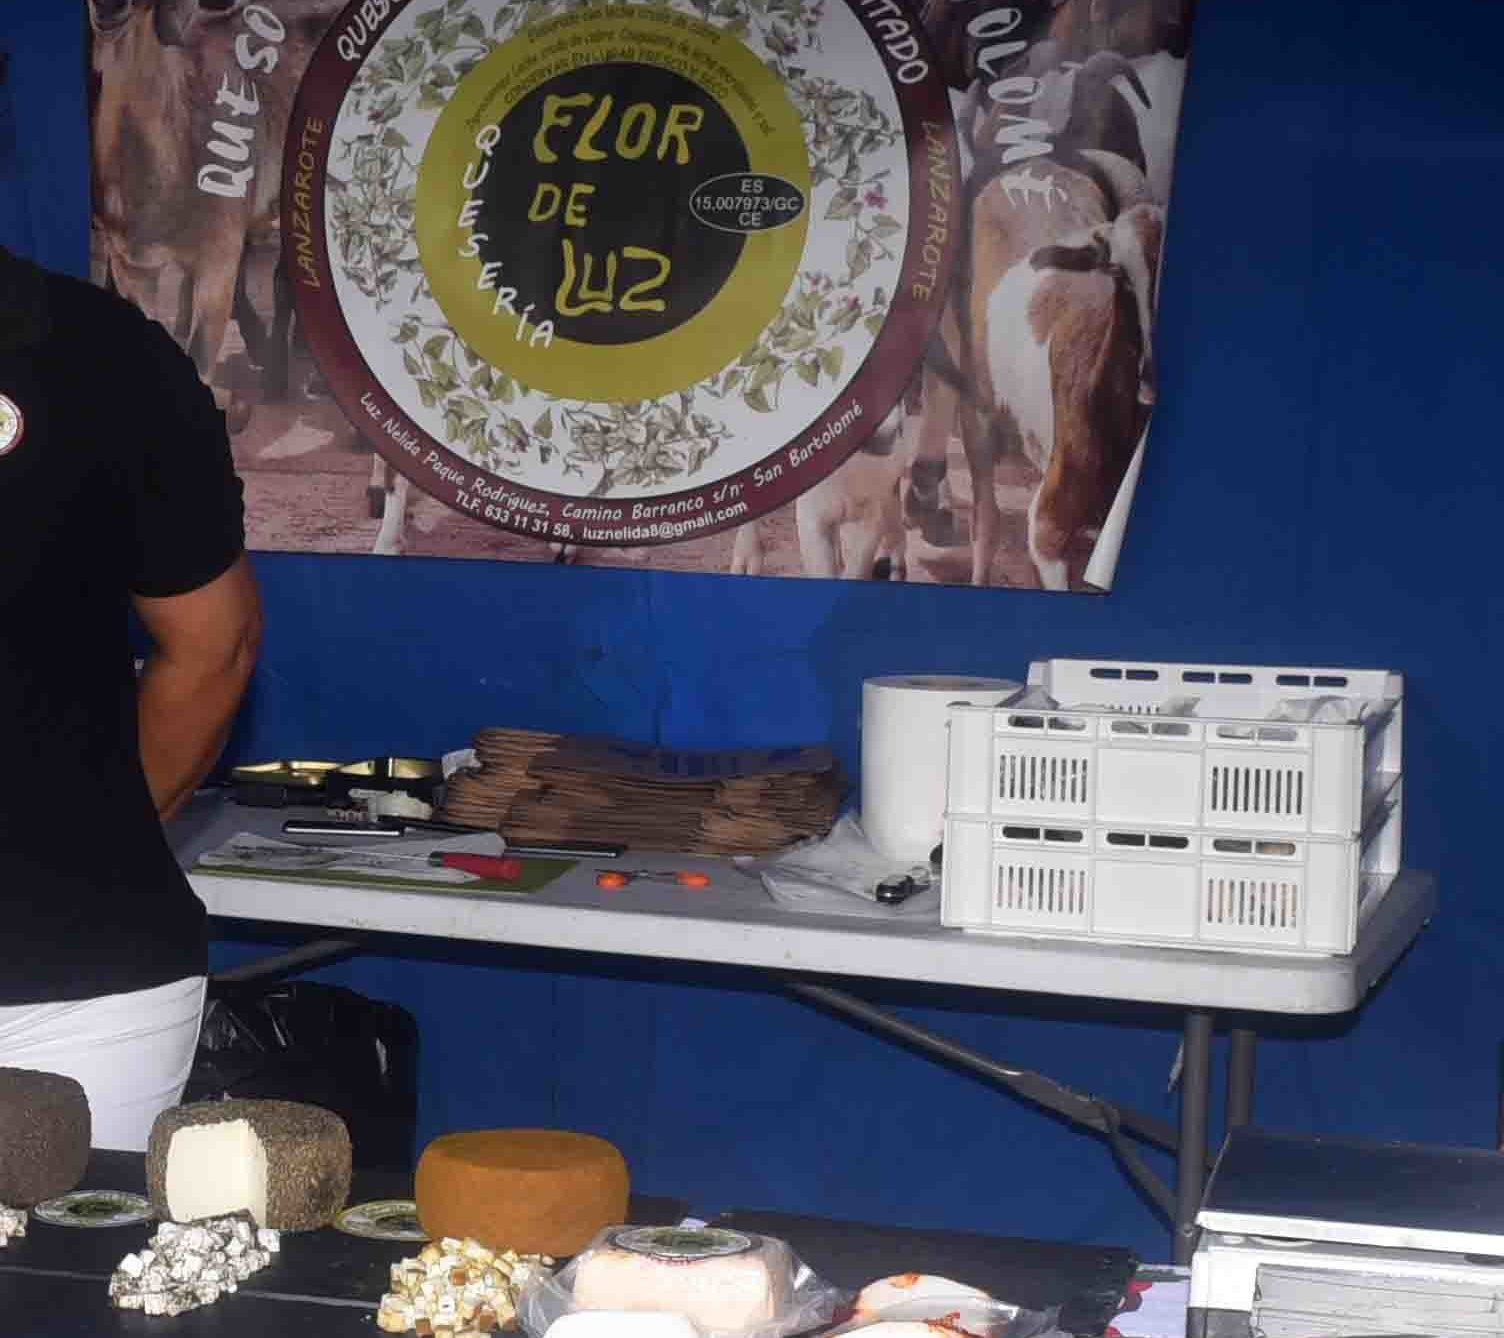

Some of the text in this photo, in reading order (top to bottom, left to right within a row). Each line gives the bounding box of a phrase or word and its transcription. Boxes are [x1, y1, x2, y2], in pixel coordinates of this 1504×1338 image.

[198, 5, 286, 198] QUESO
[533, 92, 705, 166] FLOR
[294, 116, 324, 288] LANZAROTE
[527, 182, 596, 228] DE
[739, 212, 761, 227] CE
[741, 178, 764, 194] ES
[912, 120, 951, 302] LANZAROTE
[555, 238, 671, 317] LUZ
[360, 391, 380, 420] Luz
[383, 420, 420, 456] Nelida
[424, 450, 465, 486] Paque
[472, 477, 550, 517] Rodríguez,
[562, 503, 623, 520] Camino
[632, 496, 704, 518] Barranco
[753, 464, 783, 488] San
[789, 399, 863, 466] Bartolomé
[484, 505, 510, 523] 633
[514, 513, 528, 527] 11
[531, 518, 548, 533] 31
